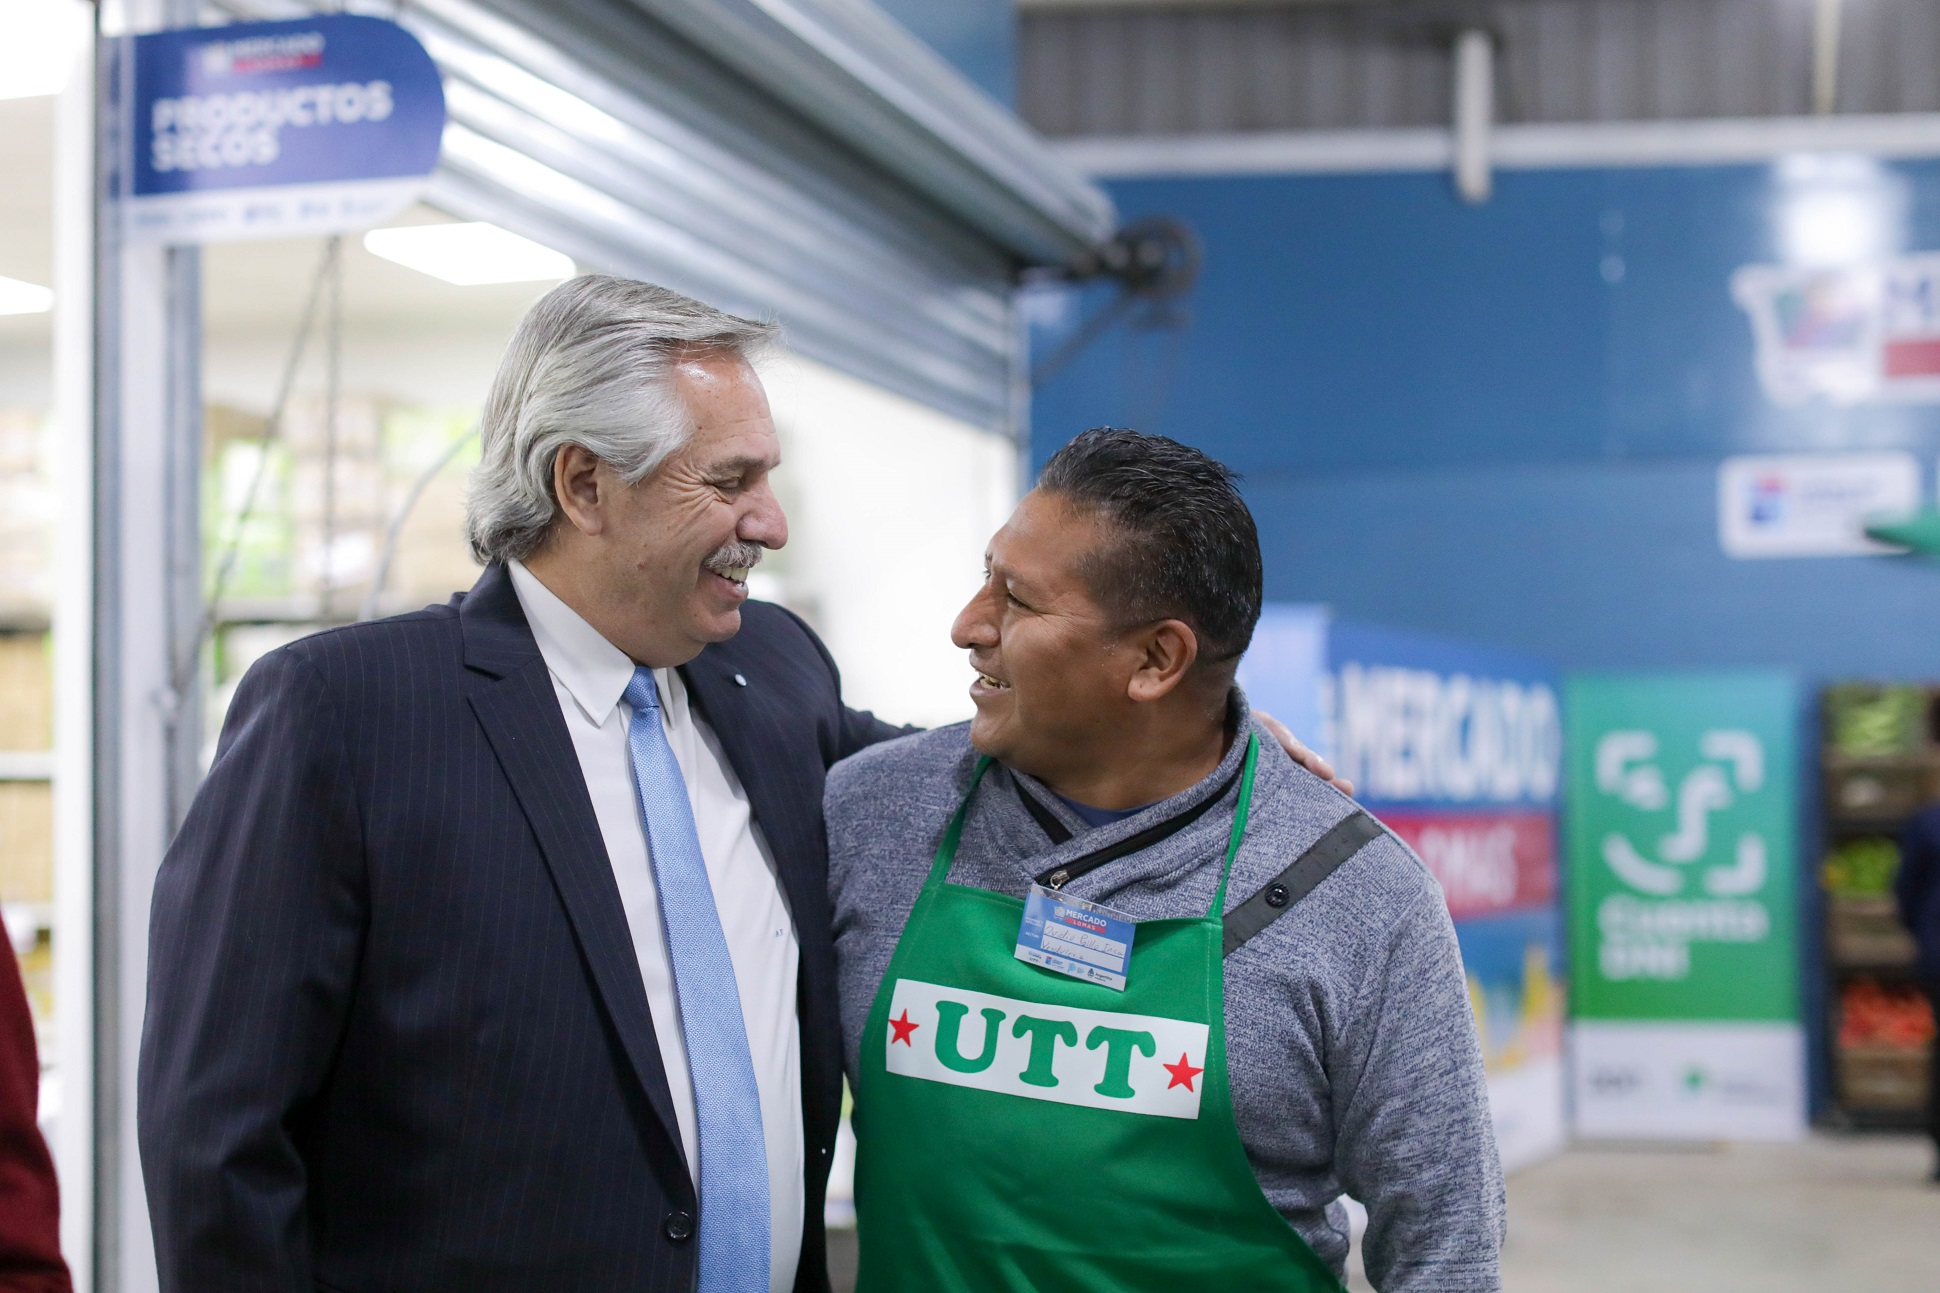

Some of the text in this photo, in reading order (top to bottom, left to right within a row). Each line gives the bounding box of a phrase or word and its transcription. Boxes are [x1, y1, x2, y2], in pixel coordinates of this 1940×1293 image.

[151, 80, 394, 131] PRODUCTOS
[151, 127, 280, 172] SECOS
[1341, 661, 1562, 801] MERCADO
[1066, 909, 1107, 927] MERCADO
[1073, 920, 1097, 931] LOMAS
[1095, 972, 1113, 981] Argentina
[934, 1000, 1157, 1099] UTT
